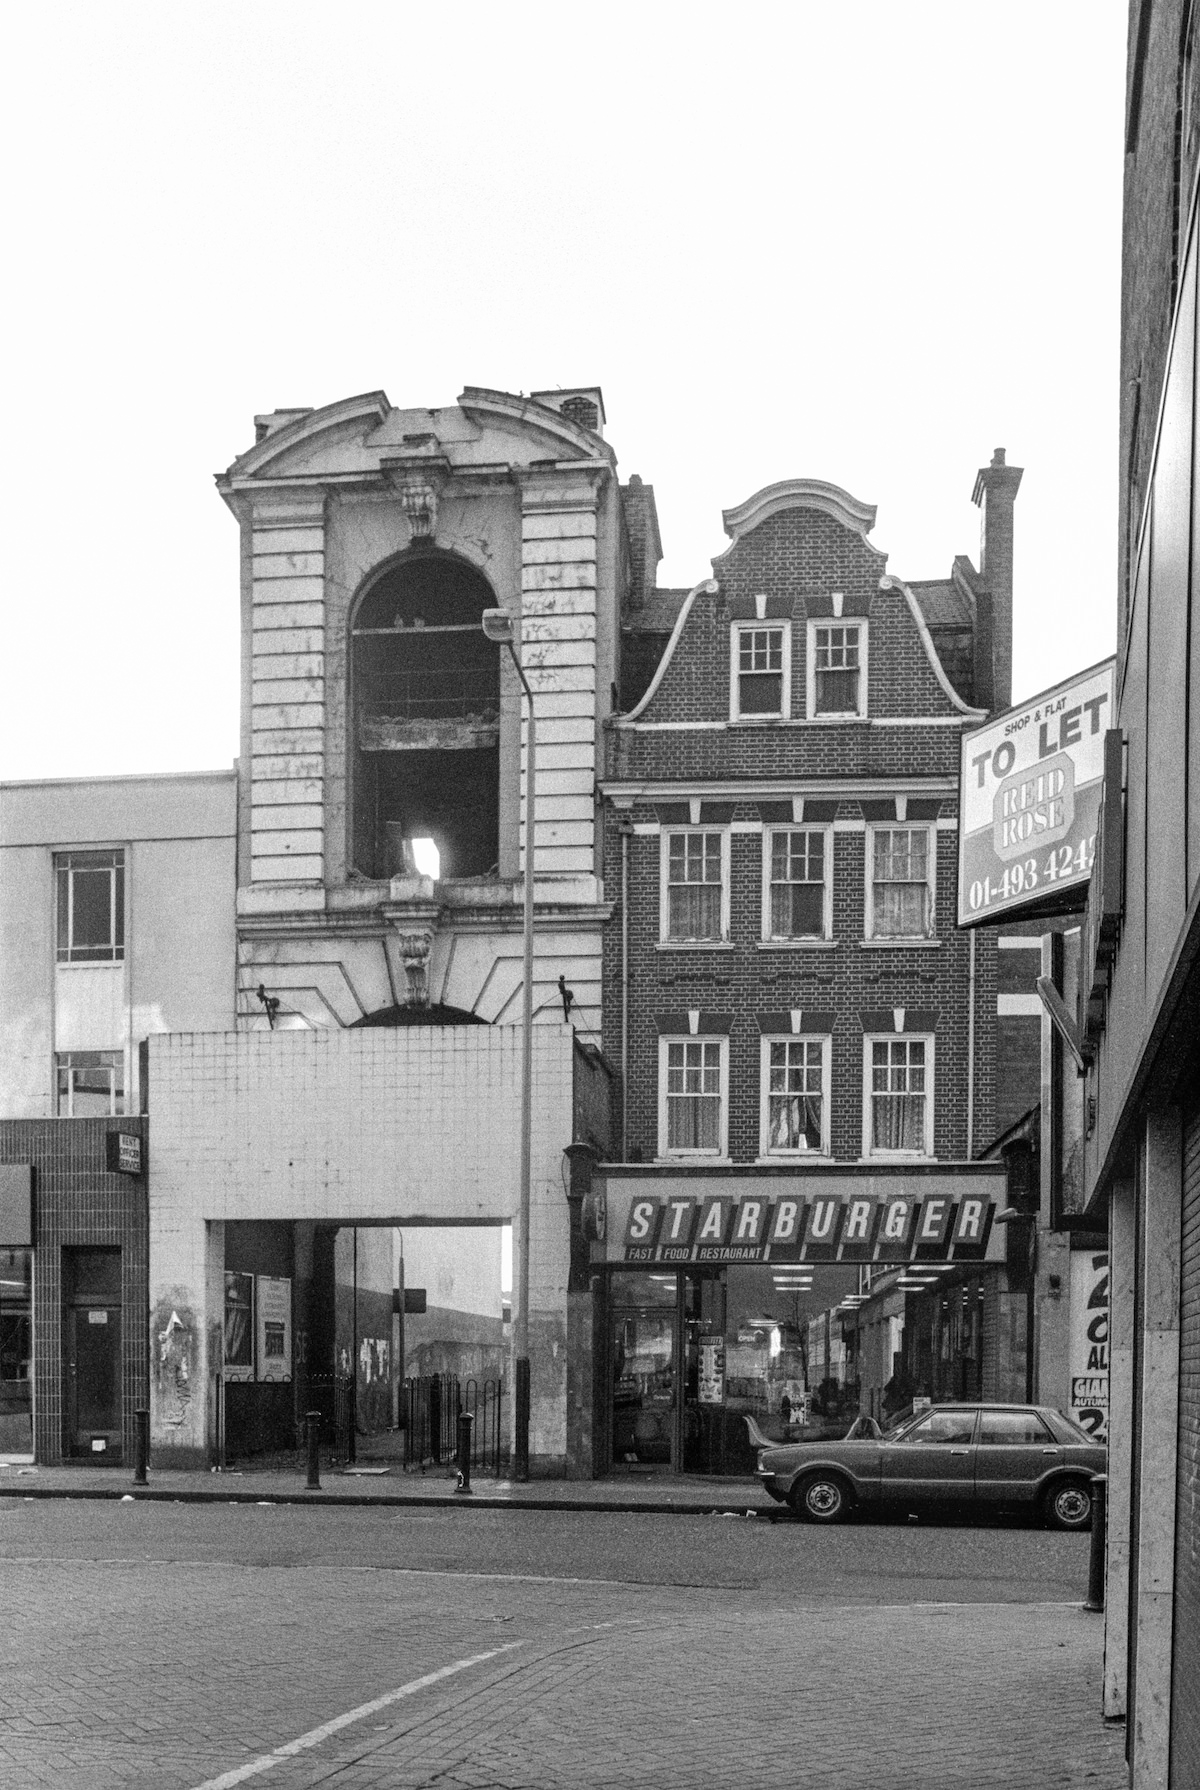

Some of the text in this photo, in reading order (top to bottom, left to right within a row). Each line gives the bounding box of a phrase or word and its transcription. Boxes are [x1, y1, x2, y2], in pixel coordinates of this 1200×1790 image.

[971, 692, 1108, 788] TO LET
[1004, 697, 1068, 737] SHOP & FLAT
[1002, 768, 1065, 817] REID
[1002, 797, 1065, 849] ROSE
[969, 858, 1038, 910] 01-493
[630, 1199, 983, 1239] STARBURGER
[628, 1246, 762, 1260] FAST FOOD RESTAURANT
